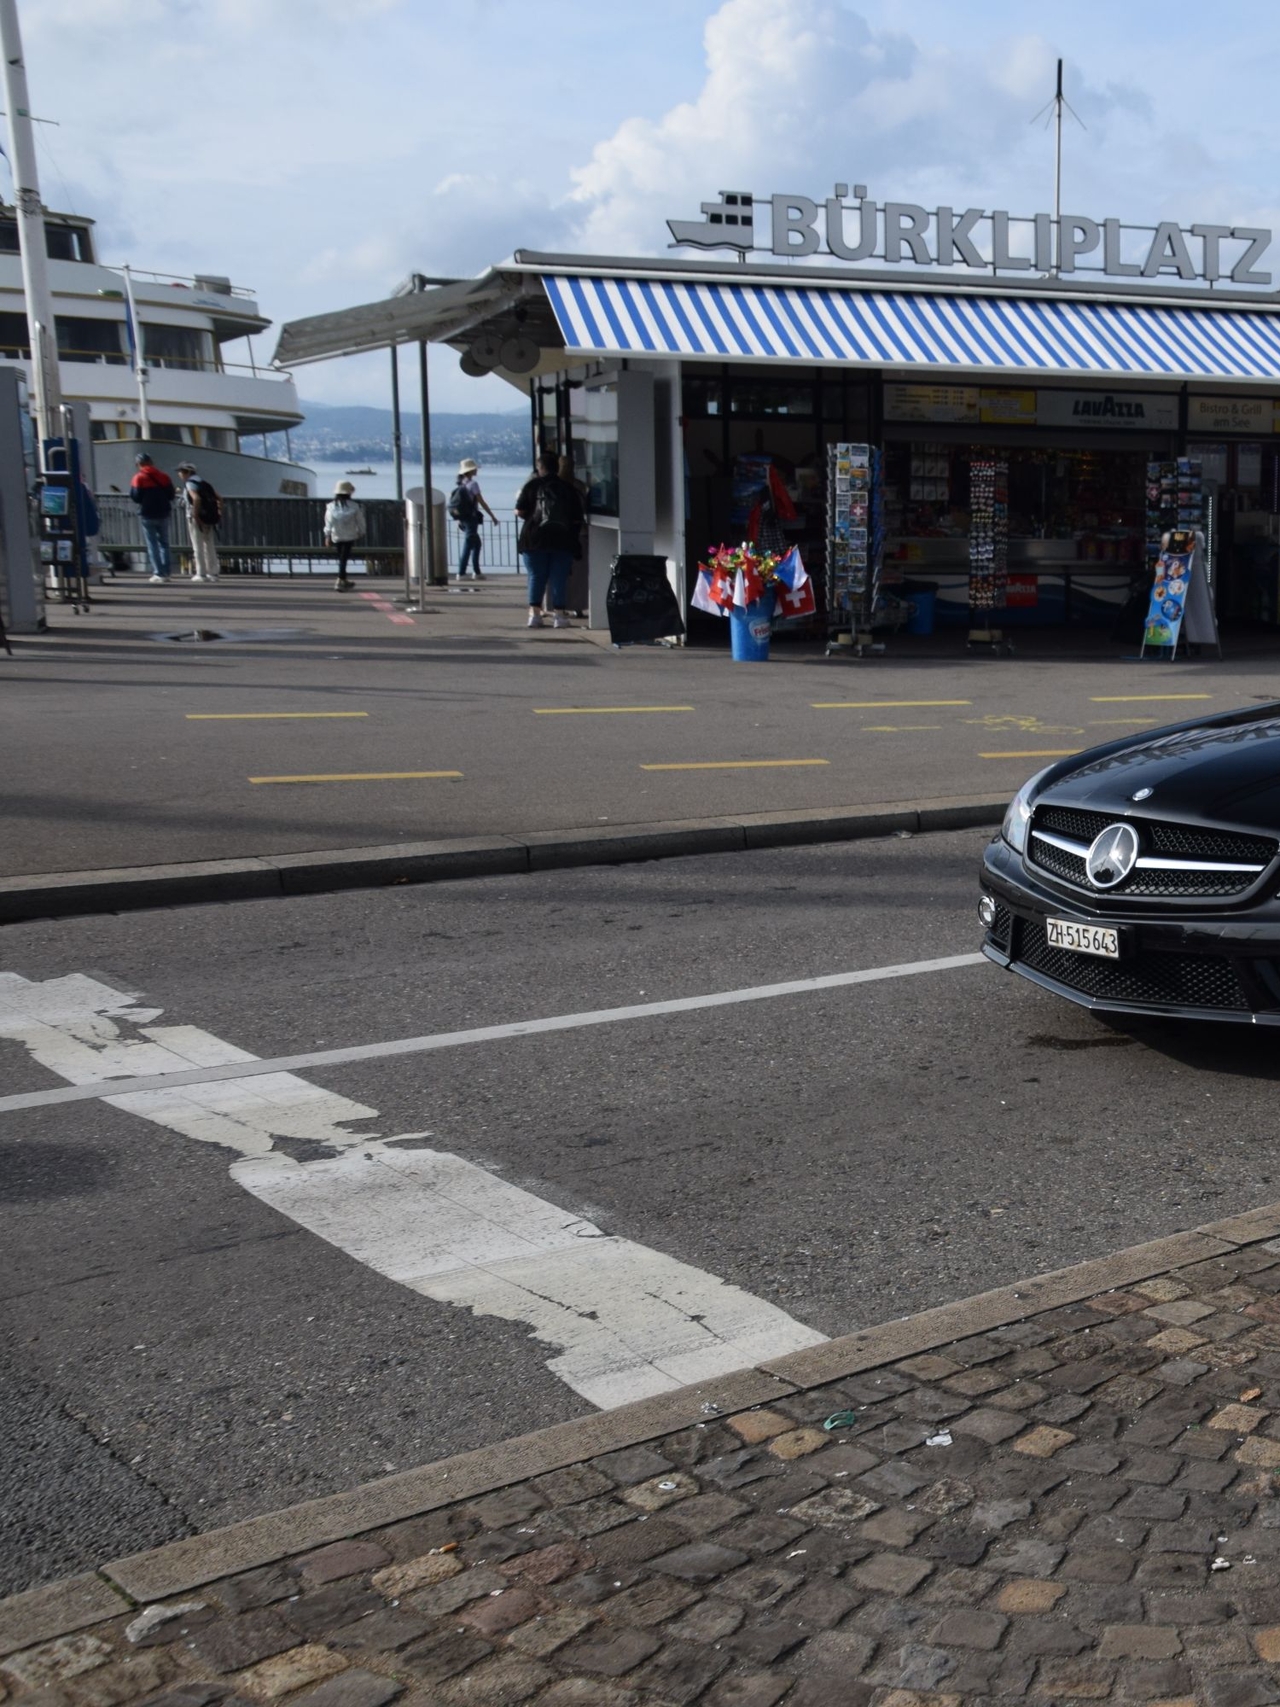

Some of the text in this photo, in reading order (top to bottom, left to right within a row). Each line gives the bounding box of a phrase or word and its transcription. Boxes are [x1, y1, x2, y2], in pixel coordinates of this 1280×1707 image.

[771, 183, 1272, 284] BÜRKLIPLATZ
[1073, 395, 1146, 418] LAVAZZA
[1199, 402, 1262, 415] Bistro & Grill
[1213, 416, 1250, 428] am See
